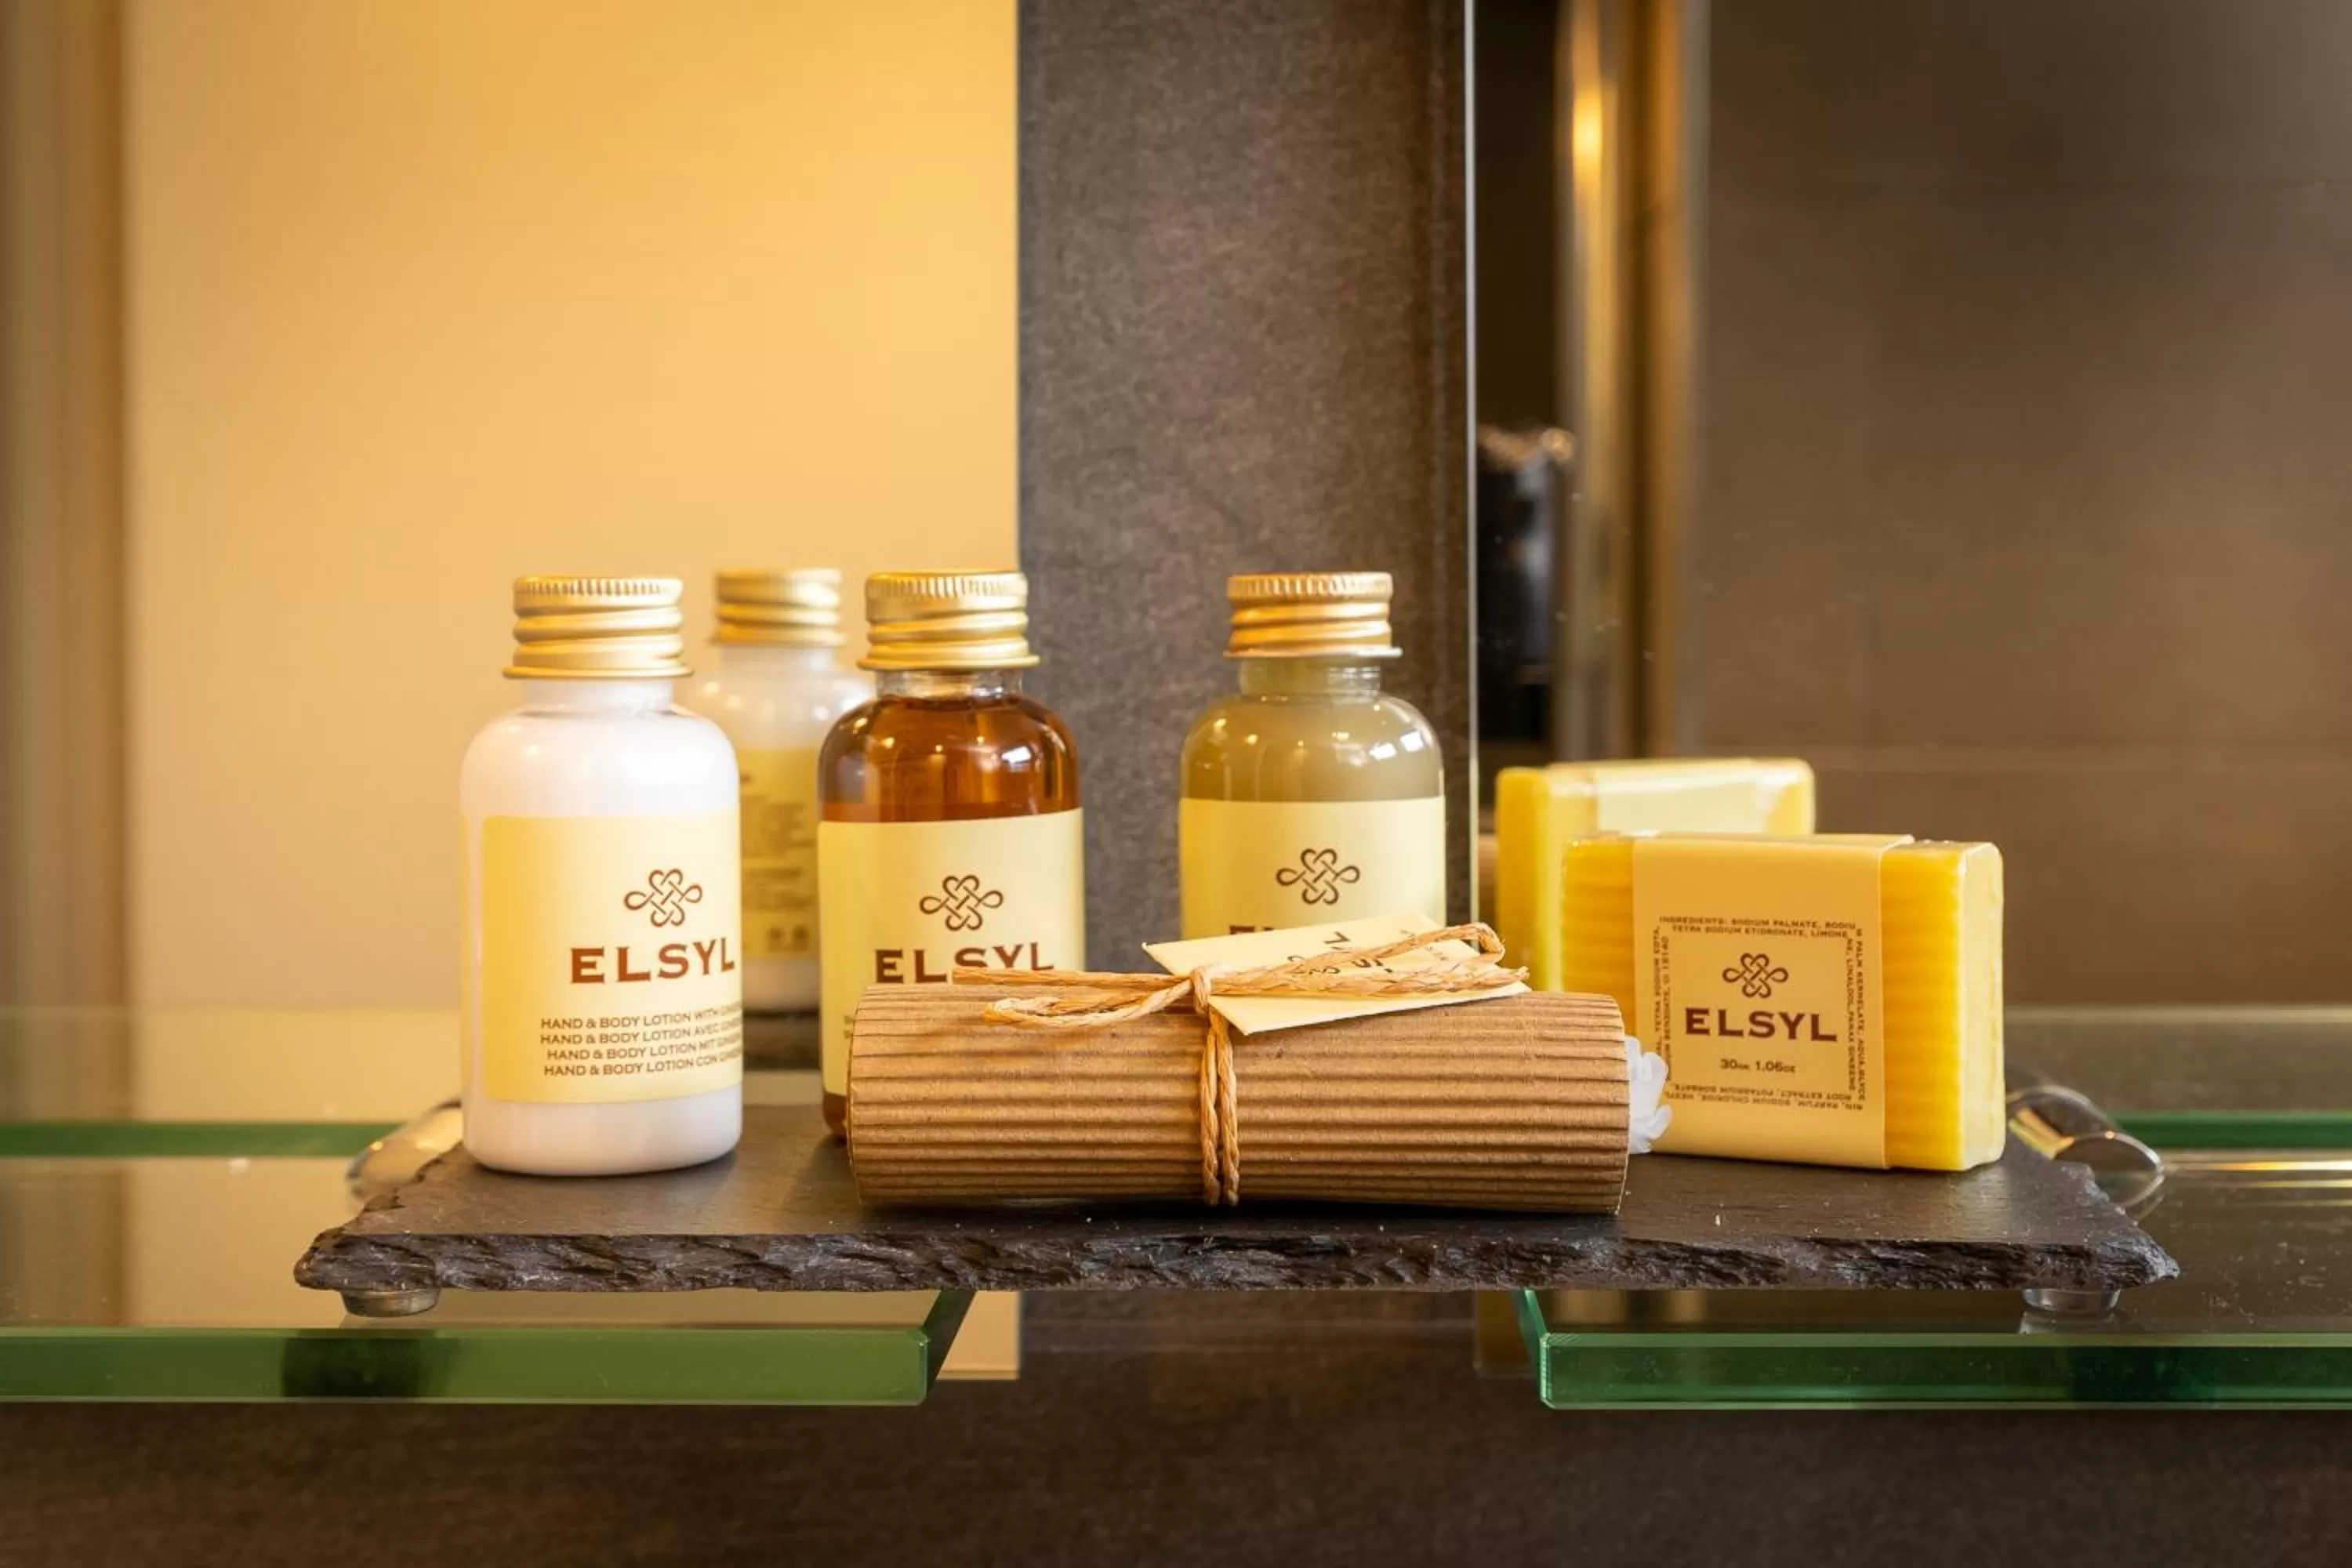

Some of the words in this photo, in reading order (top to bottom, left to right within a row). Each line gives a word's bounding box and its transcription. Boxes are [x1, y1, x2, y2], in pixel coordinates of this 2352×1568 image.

[570, 937, 735, 985] ELSYL
[875, 942, 1054, 984] ELSYL
[541, 1018, 583, 1029] HAND
[586, 1018, 597, 1029] &
[599, 1016, 641, 1029] BODY
[644, 1011, 691, 1026] LOTION
[1685, 1007, 1837, 1042] ELSYL
[540, 1034, 583, 1044] HAND
[586, 1034, 596, 1044] &
[599, 1032, 640, 1044] BODY
[643, 1027, 691, 1041] LOTION
[546, 1049, 590, 1060] HAND
[593, 1050, 603, 1059] &
[606, 1047, 646, 1059] BODY
[650, 1043, 697, 1056] LOTION
[544, 1065, 586, 1076] HAND
[590, 1065, 600, 1075] &
[603, 1062, 644, 1075] BODY
[646, 1058, 694, 1073] LOTION
